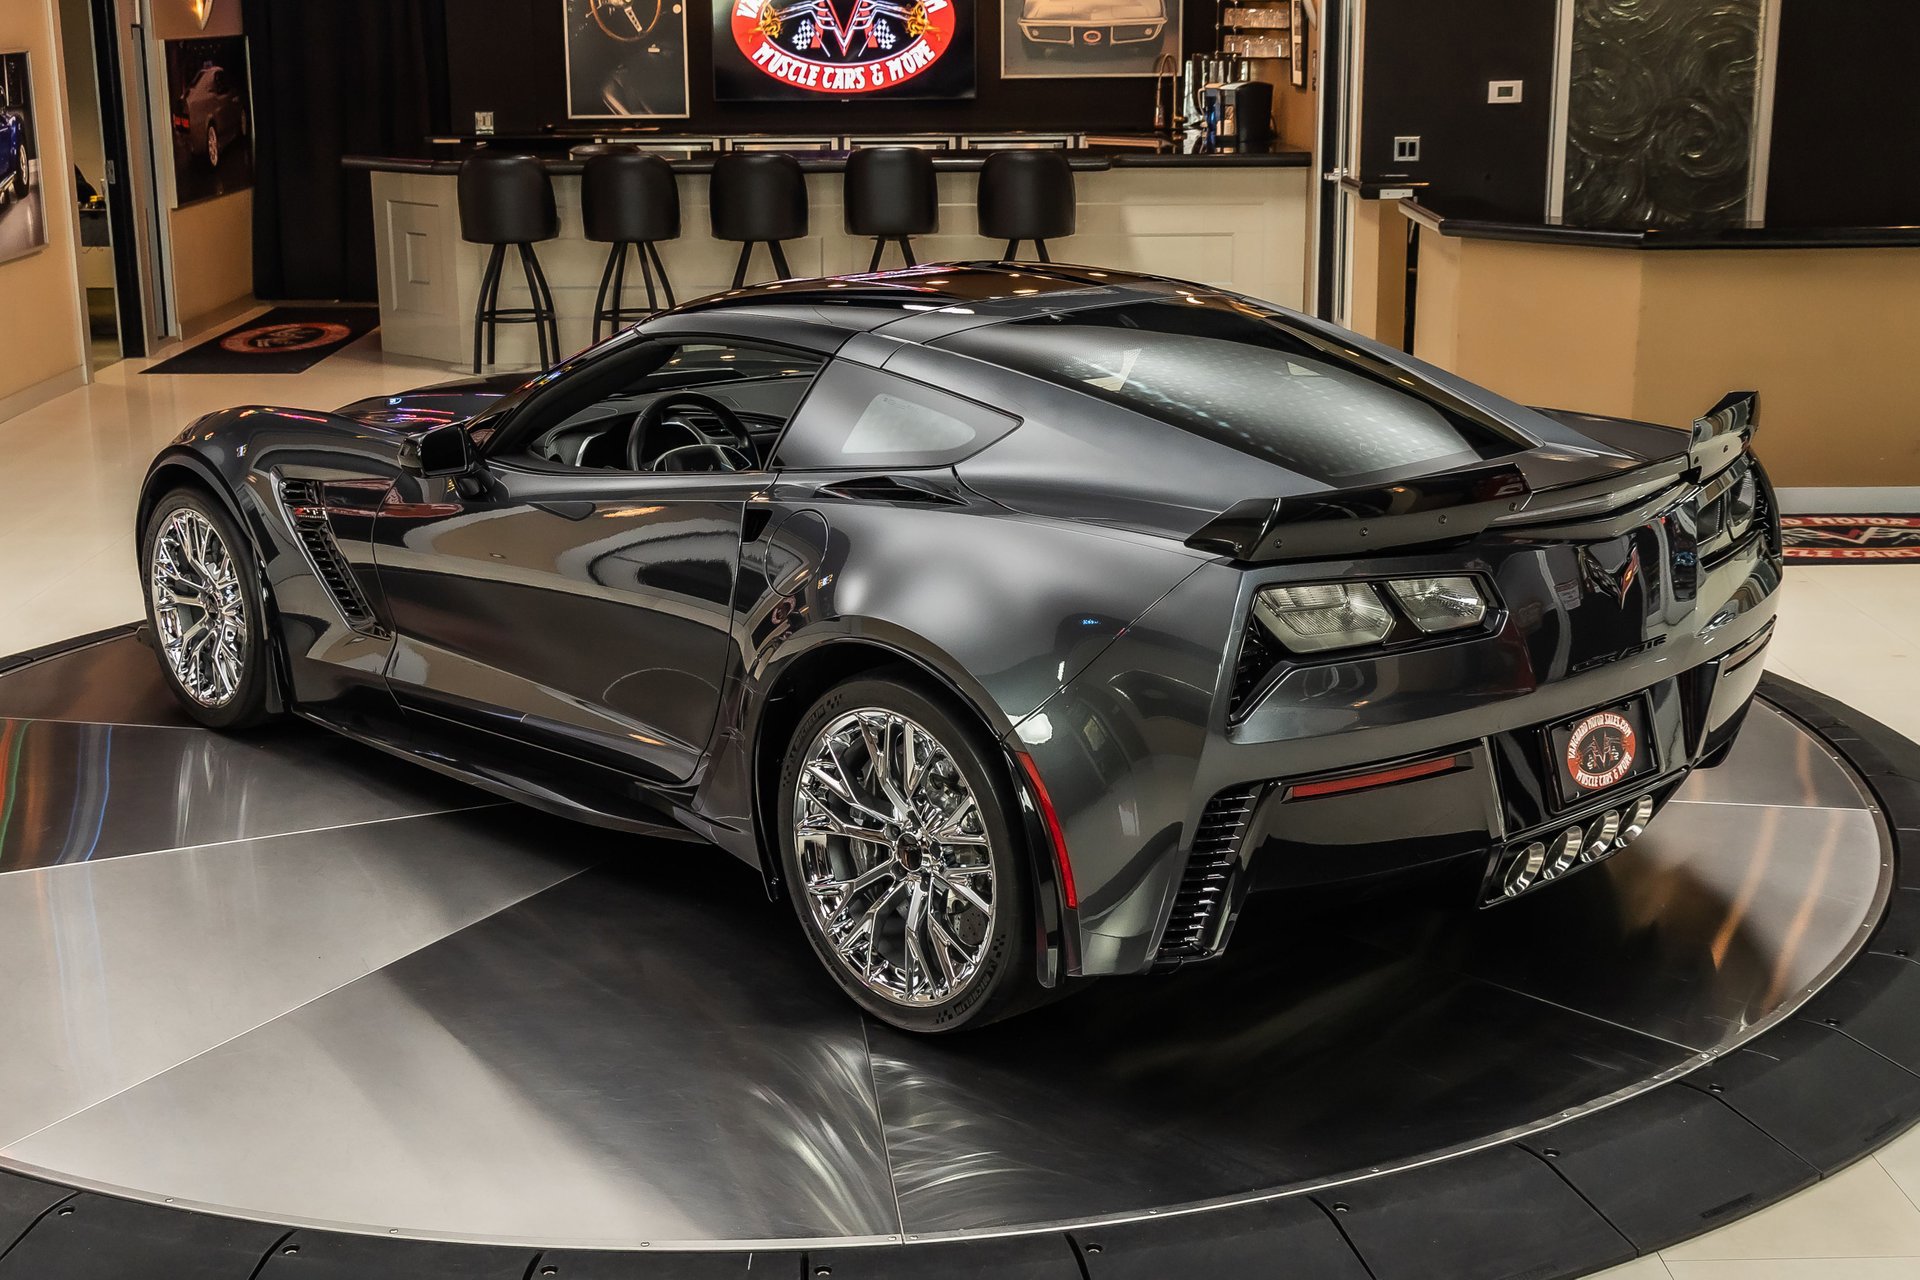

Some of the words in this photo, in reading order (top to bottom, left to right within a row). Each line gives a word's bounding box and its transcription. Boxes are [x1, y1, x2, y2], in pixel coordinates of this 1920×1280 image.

[751, 41, 821, 87] MUSCLE
[822, 66, 866, 90] CARS
[870, 64, 884, 86] &
[885, 39, 936, 82] MORE
[1808, 517, 1910, 526] MOTOR
[1782, 549, 1834, 558] CLE
[1568, 722, 1589, 759] VANGUARD
[1587, 714, 1605, 730] MOTOR
[1576, 769, 1599, 787] MUSCLE
[1598, 772, 1614, 787] CARS
[1613, 768, 1619, 780] &
[1618, 751, 1632, 777] MORE
